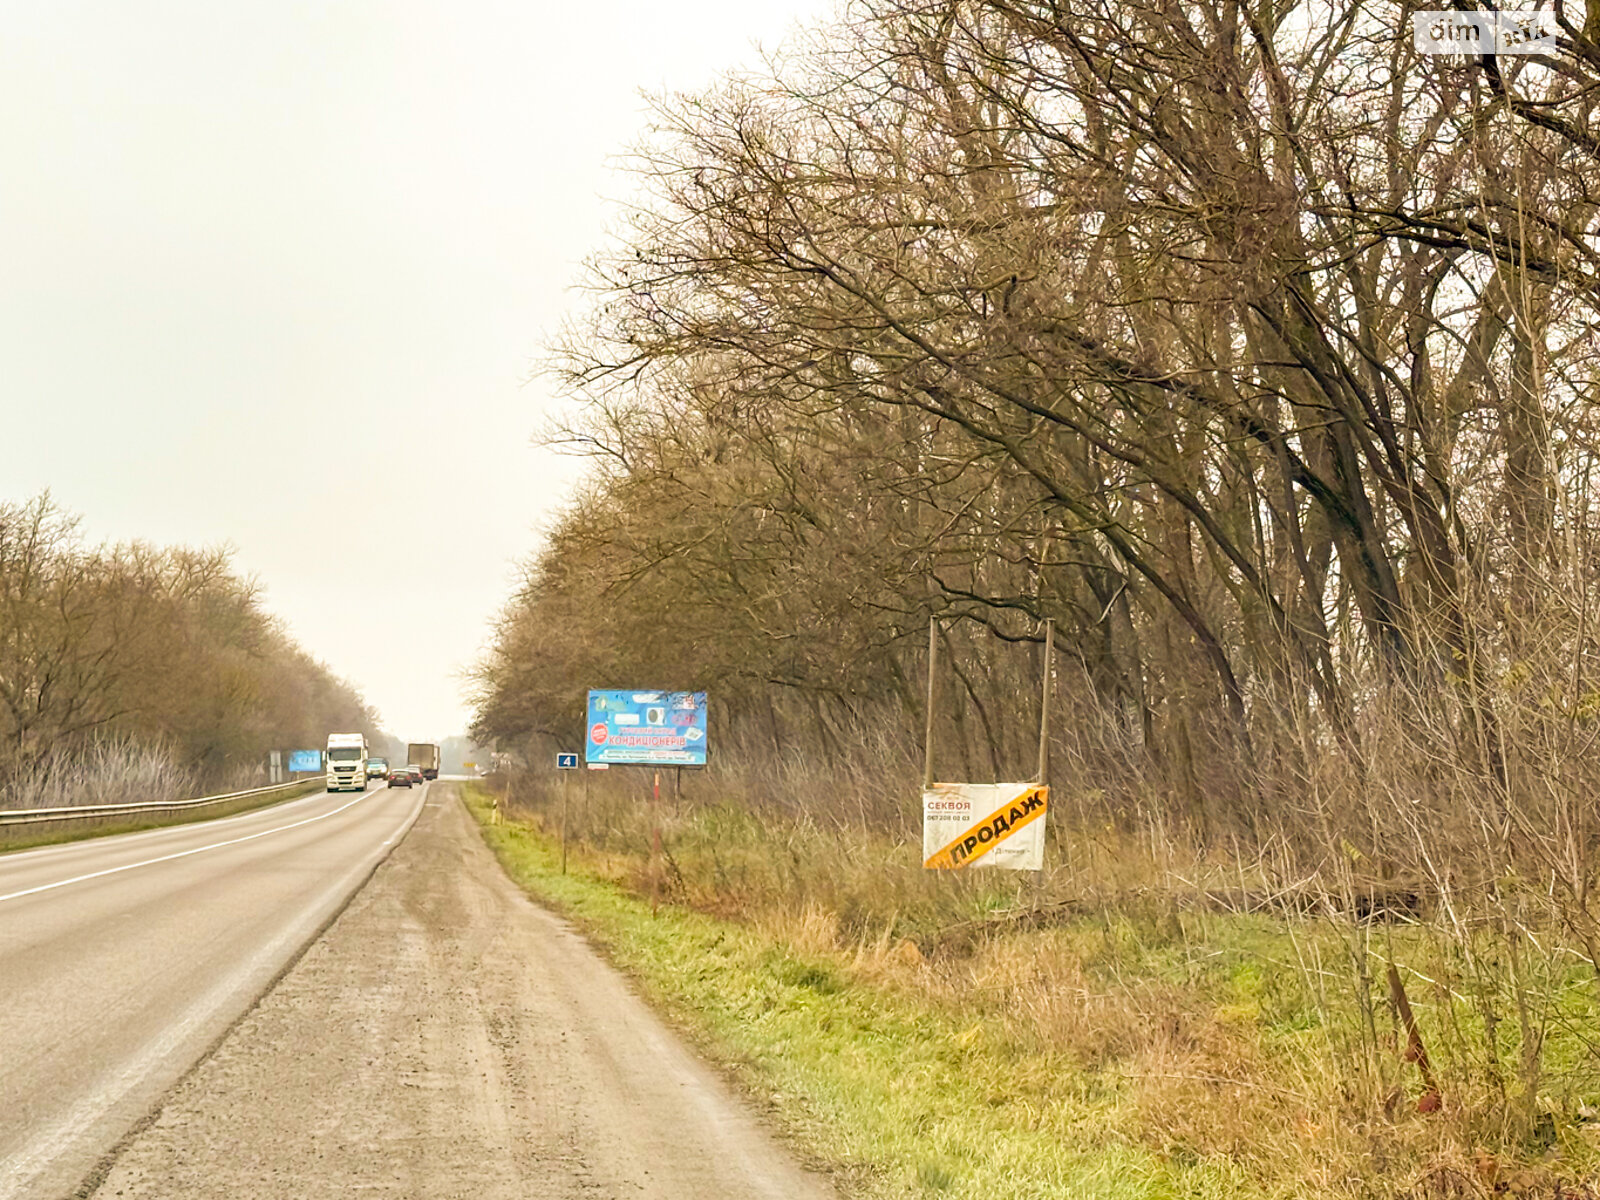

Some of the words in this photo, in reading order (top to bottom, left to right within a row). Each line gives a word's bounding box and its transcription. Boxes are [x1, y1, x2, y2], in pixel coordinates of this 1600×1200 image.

[608, 735, 686, 747] КОНДИЦІОНЕРІВ
[563, 757, 571, 766] 4
[927, 801, 970, 810] СЕКВОЯ
[950, 791, 1044, 864] ПРОДАЖ
